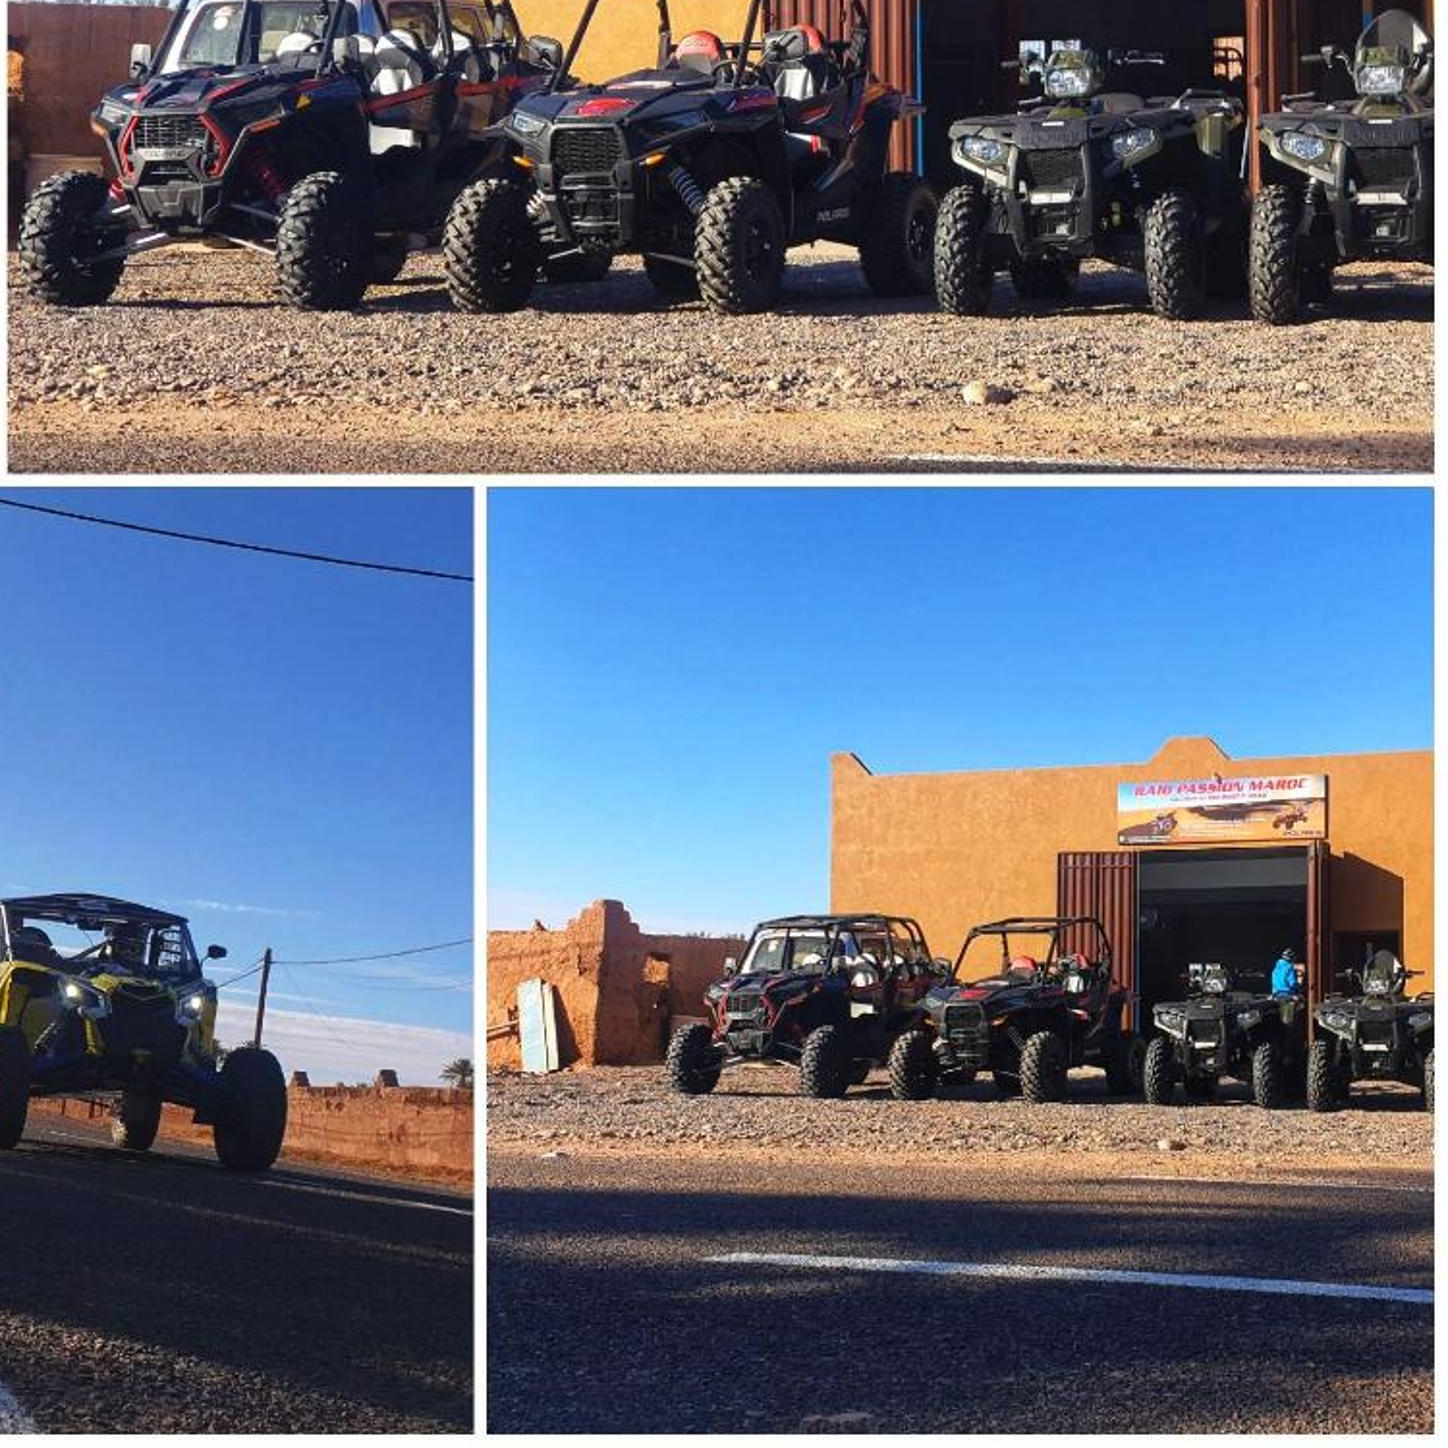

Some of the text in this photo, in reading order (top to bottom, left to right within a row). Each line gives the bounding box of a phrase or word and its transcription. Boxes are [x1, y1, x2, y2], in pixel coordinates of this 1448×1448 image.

[1134, 778, 1310, 796] RAID PASSION MAROC
